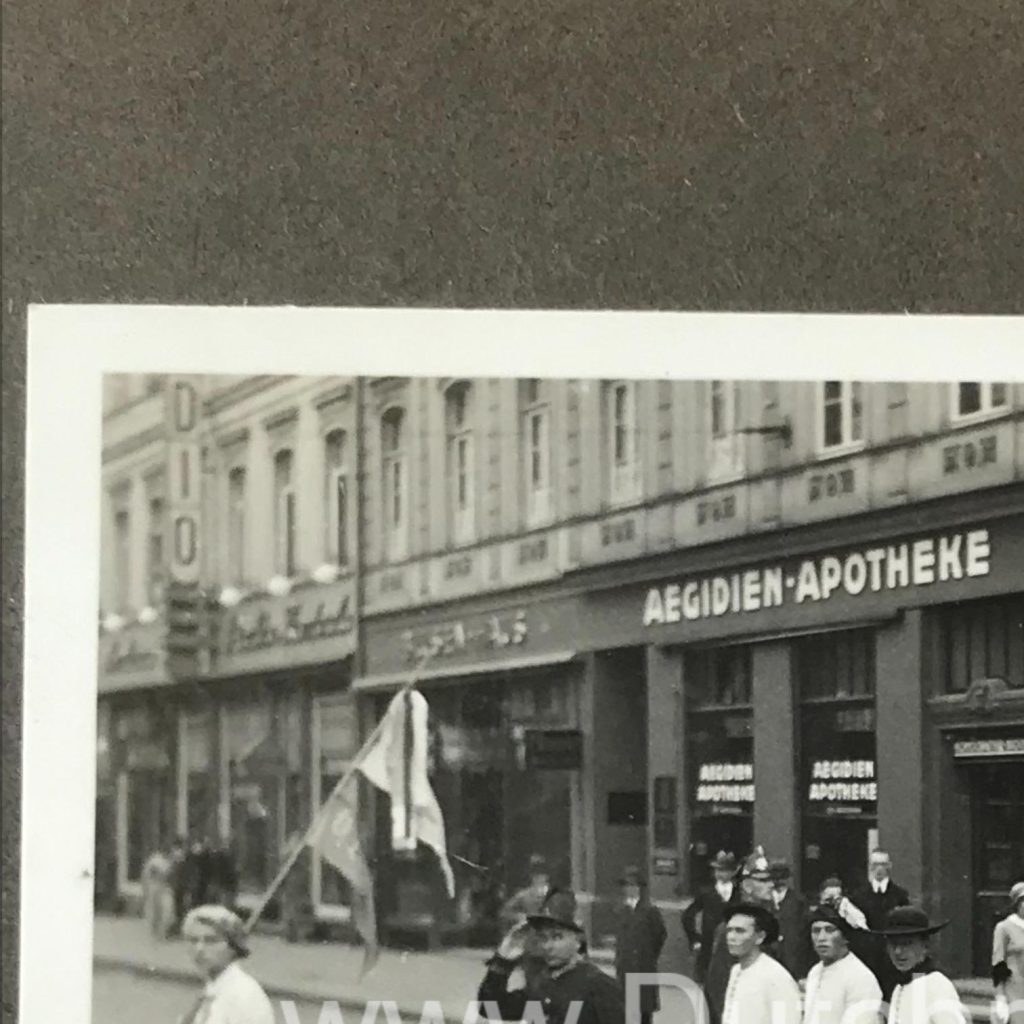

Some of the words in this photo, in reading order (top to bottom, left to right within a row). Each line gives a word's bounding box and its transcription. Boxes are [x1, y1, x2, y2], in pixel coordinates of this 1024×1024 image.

[643, 529, 991, 626] AEGIDIEN-APOTHEKE
[813, 760, 874, 779] AEGIDIEN
[809, 782, 877, 801] APOTHEKE
